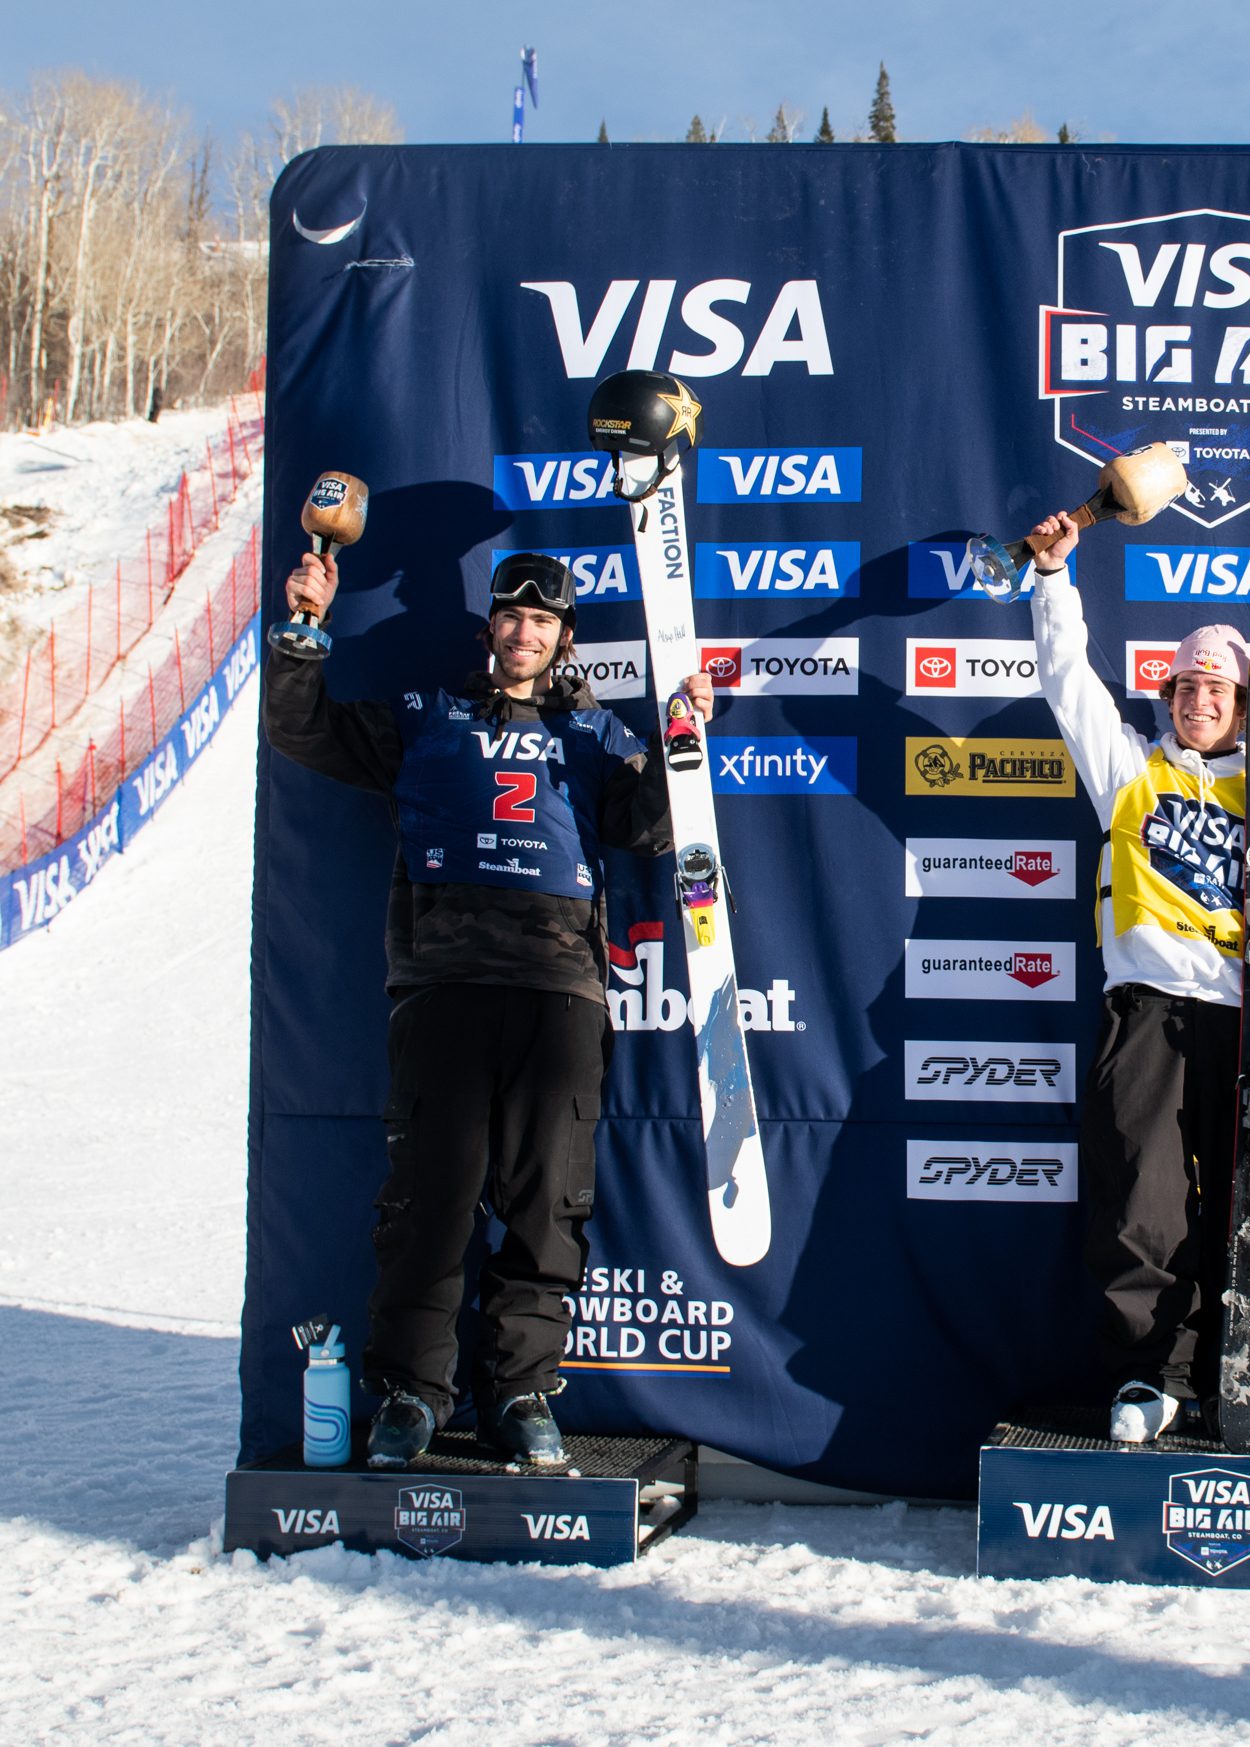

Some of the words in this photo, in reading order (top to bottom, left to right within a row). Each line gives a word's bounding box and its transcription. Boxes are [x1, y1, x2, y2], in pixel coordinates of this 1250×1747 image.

[520, 280, 834, 378] VISA
[1060, 323, 1193, 383] BIG
[593, 419, 632, 430] ROCKSTAR
[1194, 448, 1250, 459] TOYOTA
[320, 480, 342, 491] VISA
[718, 454, 841, 496] VISA
[658, 487, 684, 580] FACTION
[716, 550, 839, 592] VISA
[223, 629, 257, 700] VISA
[751, 657, 850, 678] TOYOTA
[966, 658, 1038, 678] TOYO
[181, 685, 219, 758] VISA
[470, 731, 566, 765] VISA
[133, 741, 179, 816] VISA
[719, 746, 828, 784] xfinity
[968, 752, 1065, 780] PACIFICO
[493, 771, 537, 823] 2
[1167, 799, 1245, 851] VISA
[501, 838, 548, 850] TOYOTA
[478, 858, 541, 876] Steamboat
[922, 855, 1013, 872] guaranteed
[1016, 856, 1051, 871] Rate
[13, 854, 77, 931] VISA
[921, 957, 1013, 974] guaranteed
[1016, 957, 1052, 973] Rate
[917, 1057, 1062, 1088] SPYDER
[919, 1157, 1064, 1187] SPYDER
[660, 1270, 684, 1295] &
[658, 1329, 732, 1360] CUP
[408, 1492, 453, 1508] VISA
[1182, 1479, 1250, 1505] VISA
[272, 1508, 339, 1534] VISA
[399, 1511, 427, 1525] BIG
[431, 1512, 460, 1526] AIR
[521, 1514, 590, 1540] VISA
[1013, 1503, 1115, 1540] VISA
[1169, 1507, 1211, 1529] BIG
